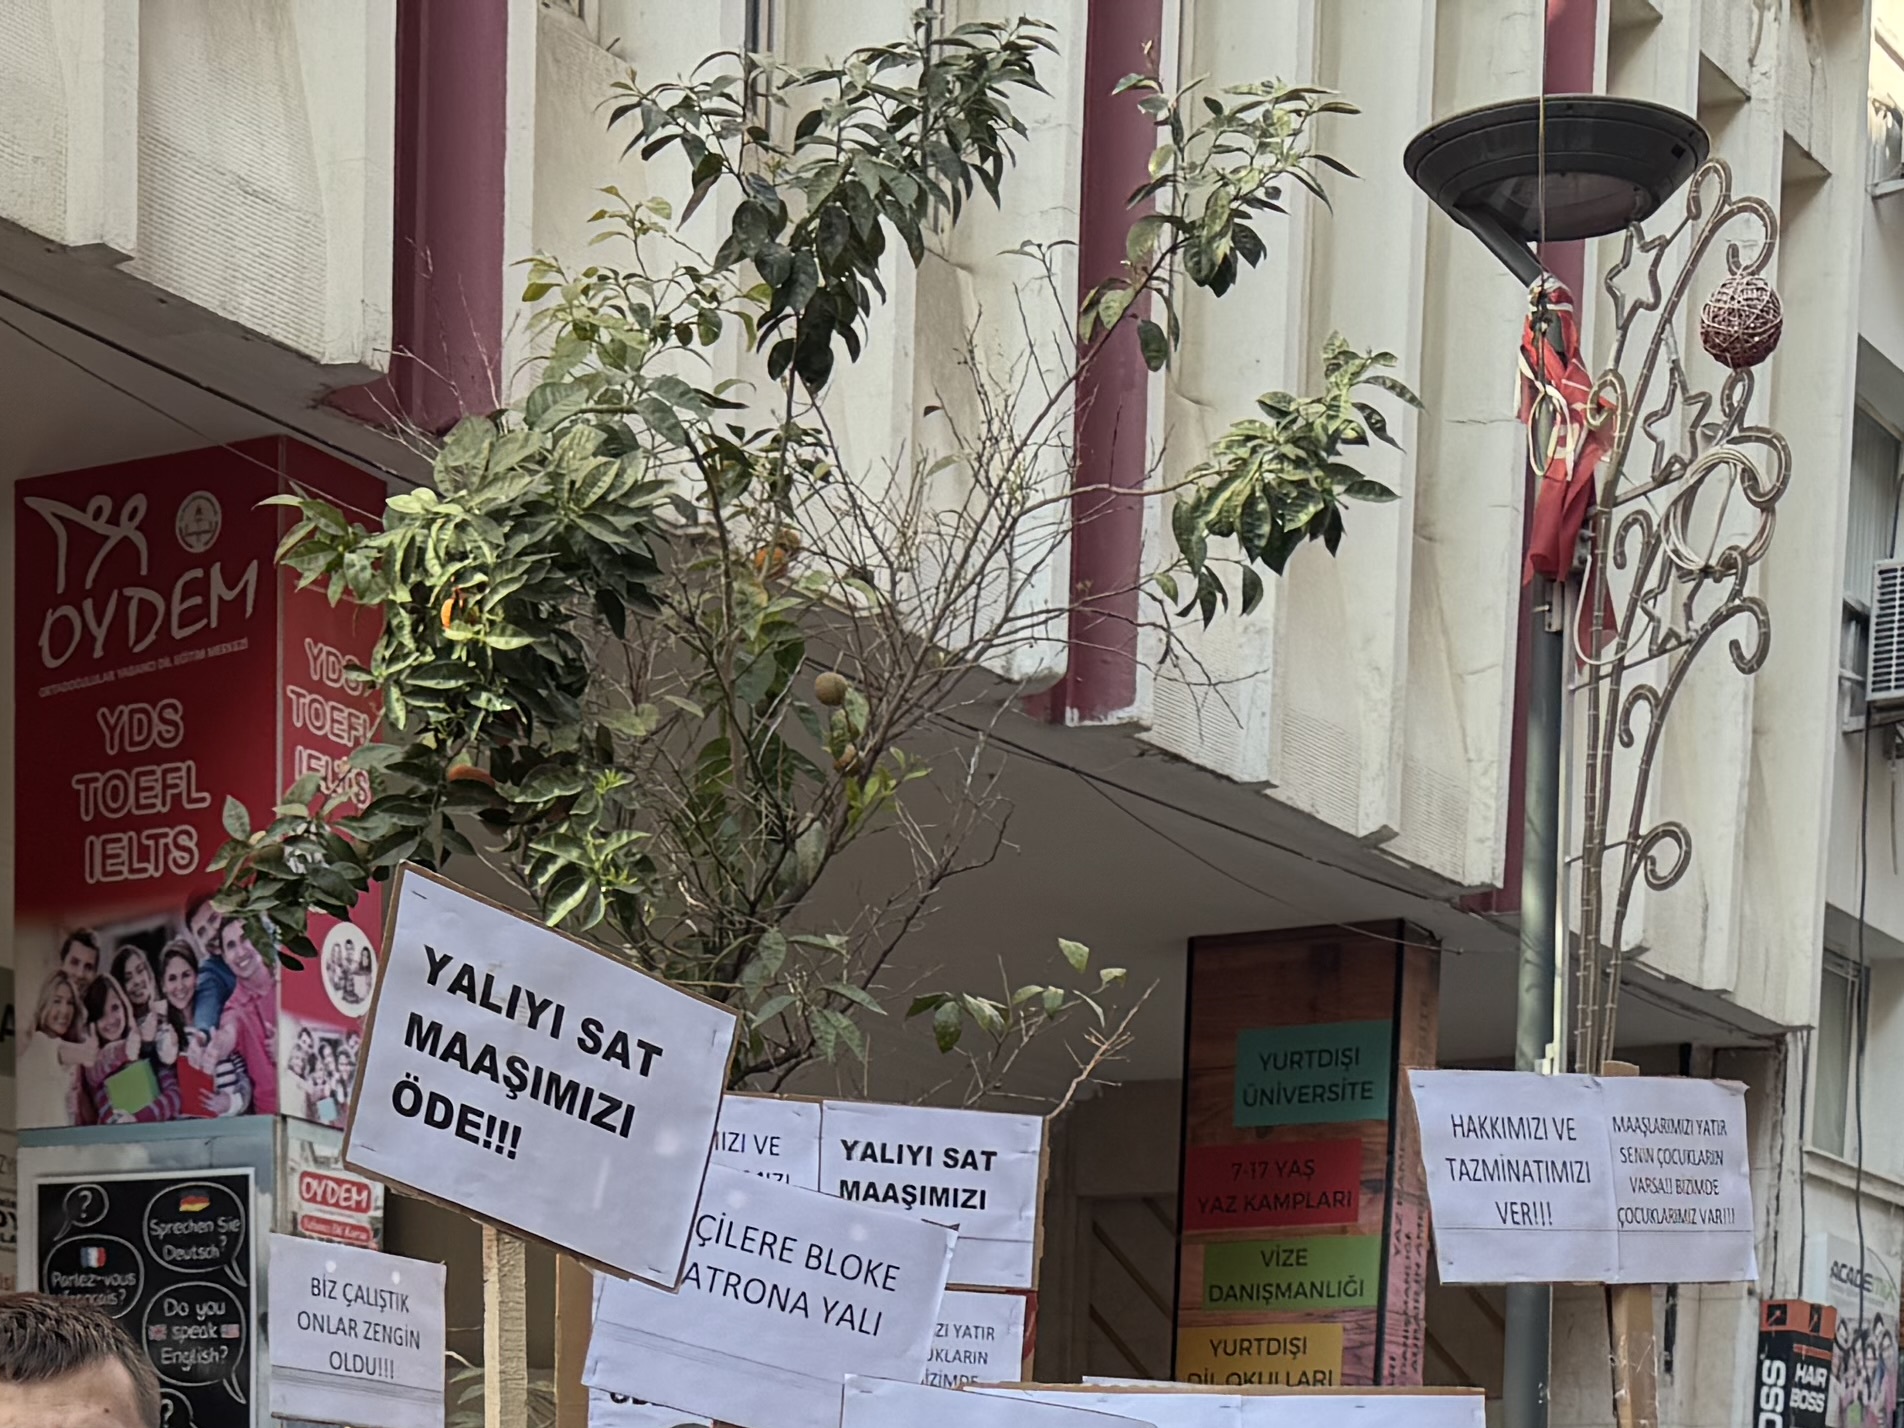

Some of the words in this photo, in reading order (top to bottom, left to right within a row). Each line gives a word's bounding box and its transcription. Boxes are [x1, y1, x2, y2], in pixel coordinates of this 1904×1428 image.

[38, 558, 259, 669] OYDEM
[97, 698, 184, 756] YDS
[72, 760, 212, 822] TOEFL
[85, 824, 198, 884] IELTS
[423, 944, 566, 1042] YALIYI
[576, 1016, 665, 1080] SAT
[403, 1011, 637, 1140] MAAŞIMIZI
[1258, 1046, 1362, 1075] YURTDIŞI
[1243, 1077, 1374, 1108] ÜNİVERSİTE
[390, 1072, 522, 1161] ÖDE!!!
[1451, 1113, 1548, 1141] HAKKIMIZI
[1553, 1116, 1577, 1141] VE
[753, 1134, 781, 1157] VE
[840, 1138, 933, 1168] YALIYI
[942, 1147, 999, 1173] SAT
[1231, 1161, 1271, 1183] 7-17
[1276, 1158, 1316, 1183] YAŞ
[1445, 1153, 1592, 1184] TAZMİNATIMIZI
[300, 1176, 369, 1209] OYDEM
[1198, 1192, 1238, 1215] YAZ
[1241, 1189, 1353, 1213] KAMPLARI
[149, 1217, 215, 1239] Sprechen
[217, 1216, 240, 1235] Sie
[1495, 1200, 1553, 1226] VER!!!
[804, 1242, 901, 1293] BLOKE
[1259, 1244, 1309, 1269] VİZE
[310, 1273, 338, 1300] BİZ
[343, 1282, 411, 1314] ÇALIŞTIK
[1208, 1272, 1365, 1306] DANIŞMANLIĞI
[163, 1298, 190, 1317] Do
[195, 1300, 227, 1321] you
[822, 1296, 883, 1338] YALI
[171, 1322, 218, 1342] speak
[297, 1310, 359, 1341] ONLAR
[362, 1317, 421, 1351] ZENGİN
[951, 1322, 996, 1342] YATIR
[160, 1346, 229, 1372] English?
[1209, 1334, 1309, 1361] YURTDIŞI
[328, 1350, 395, 1381] OLDU!!!
[1795, 1361, 1828, 1389] HAIR
[1789, 1387, 1826, 1414] BOSS
